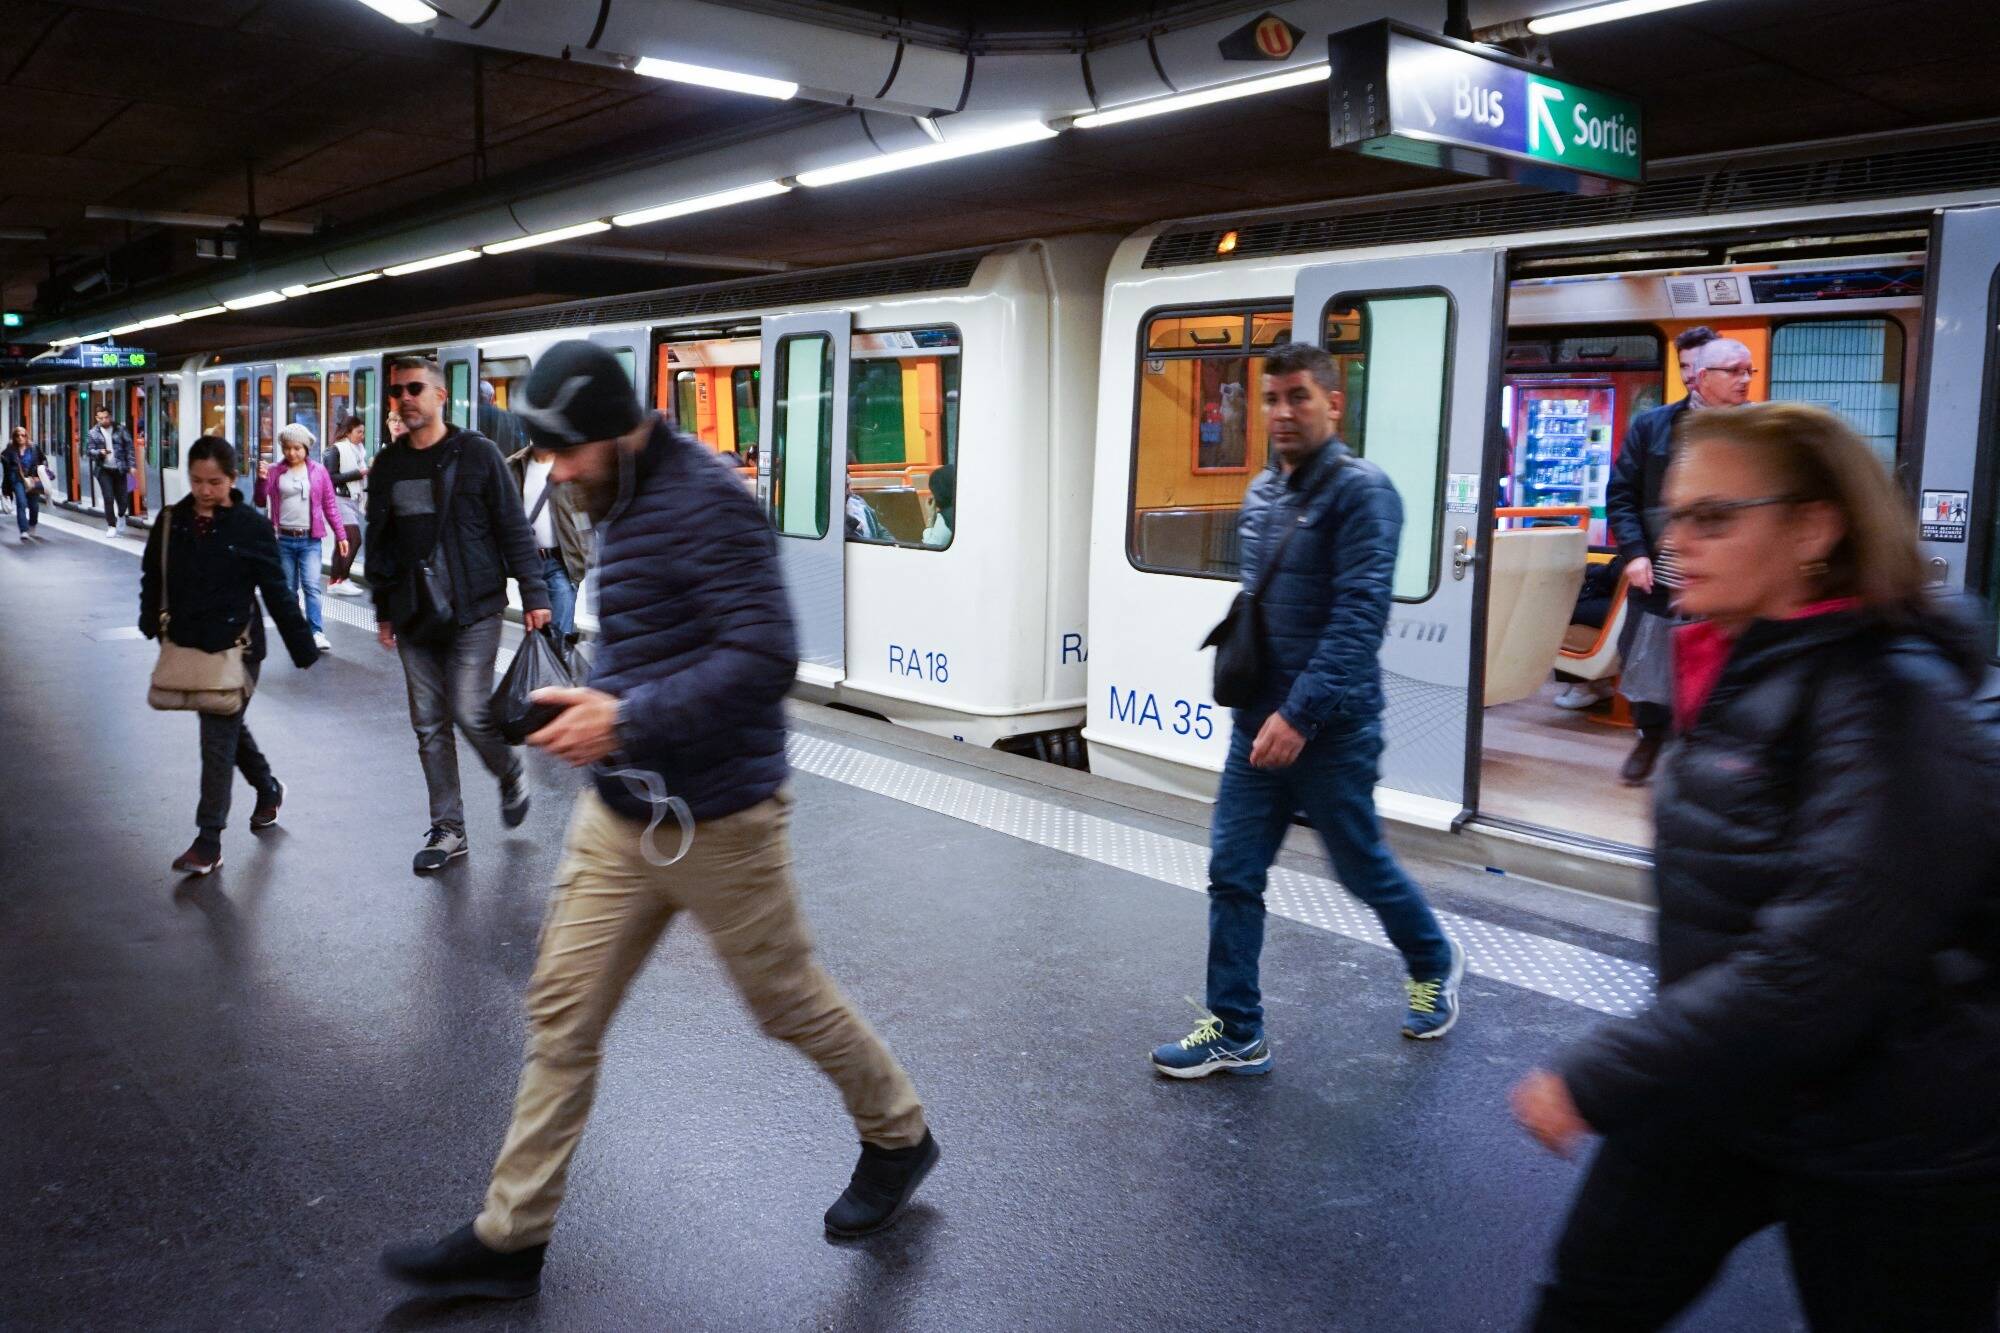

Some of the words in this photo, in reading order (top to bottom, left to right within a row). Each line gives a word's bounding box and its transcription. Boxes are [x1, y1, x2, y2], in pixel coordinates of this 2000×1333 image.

[1455, 75, 1504, 127] Bus
[1573, 103, 1637, 156] Sortie
[889, 645, 948, 683] RA18
[1109, 686, 1162, 730] MA
[1172, 700, 1213, 740] 35
